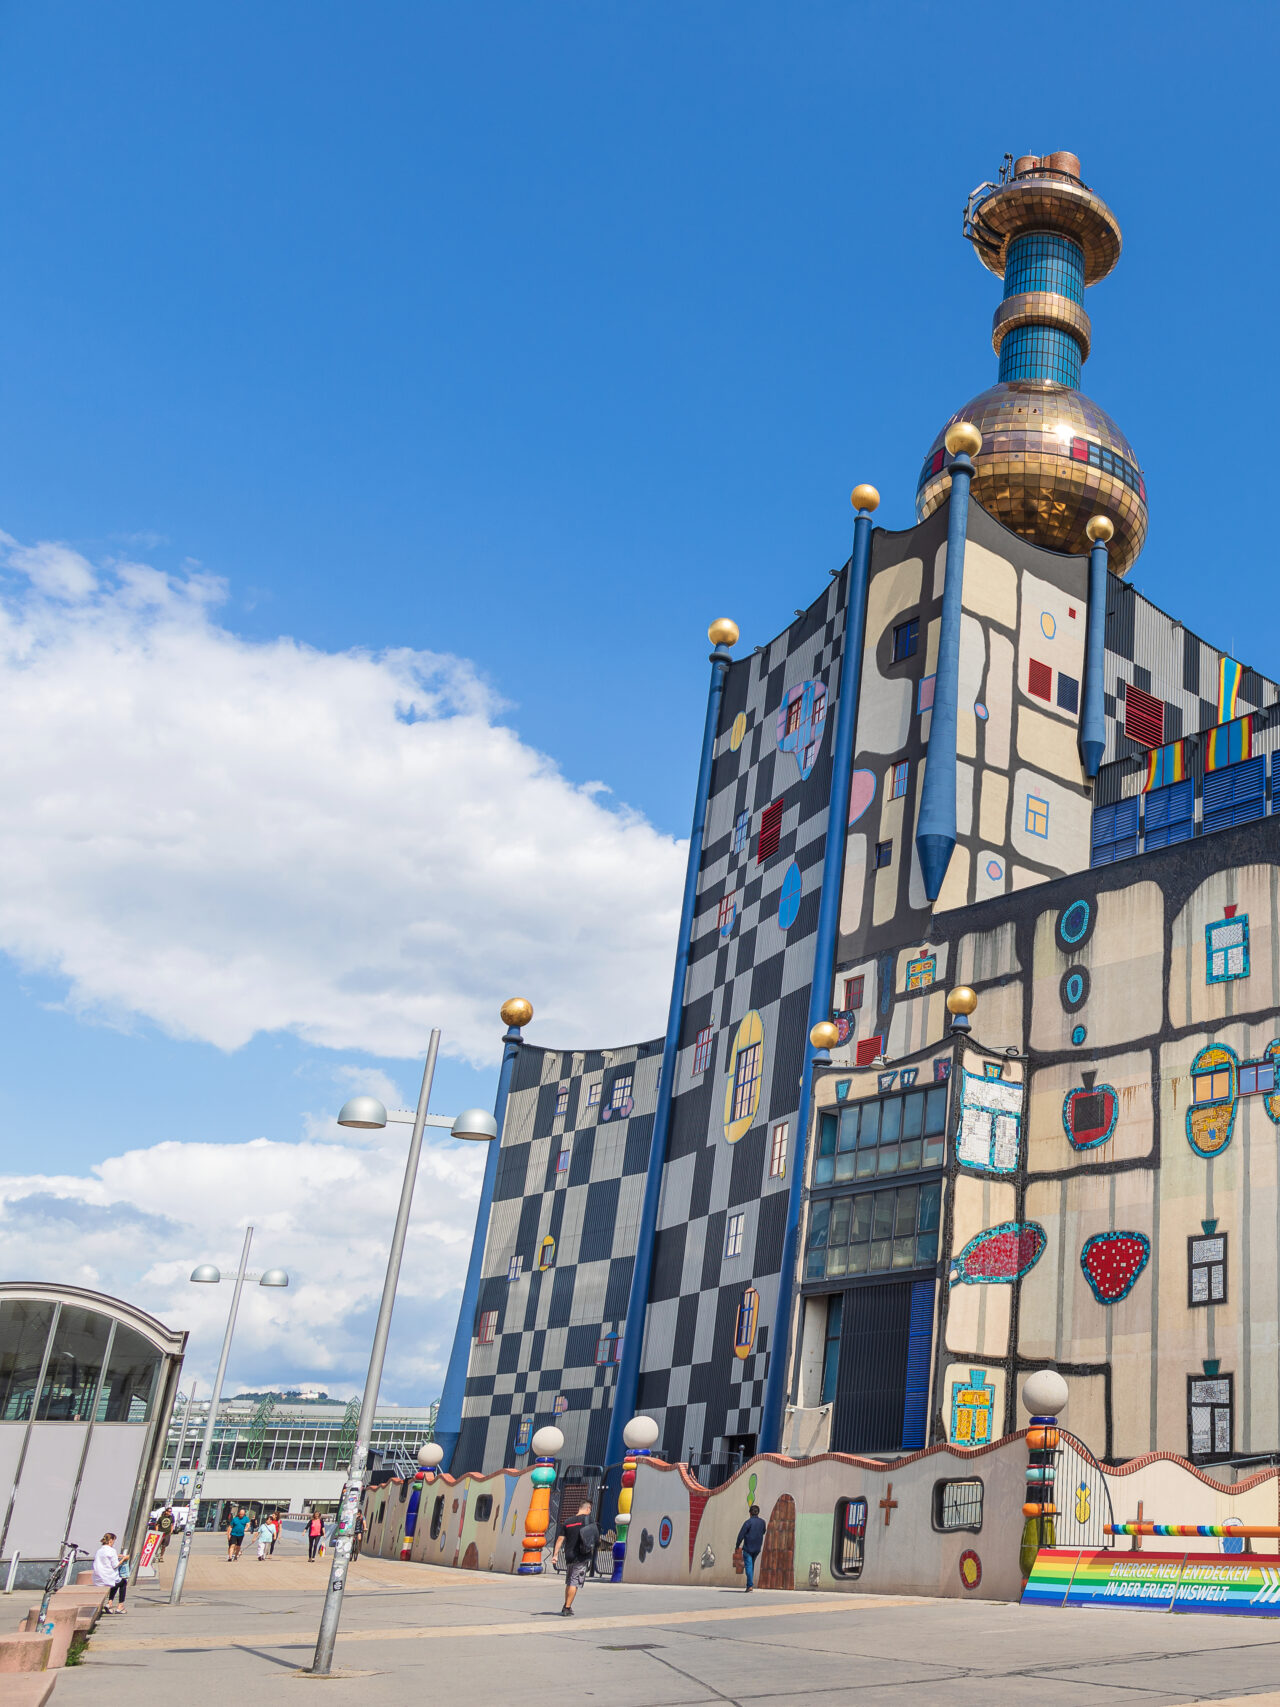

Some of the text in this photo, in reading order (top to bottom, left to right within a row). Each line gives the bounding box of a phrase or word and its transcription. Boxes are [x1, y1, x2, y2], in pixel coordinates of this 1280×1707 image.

[1109, 1562, 1252, 1581] ENERGIE NEU ENTDECKEN
[1103, 1582, 1118, 1596] IN
[1117, 1582, 1141, 1597] DER
